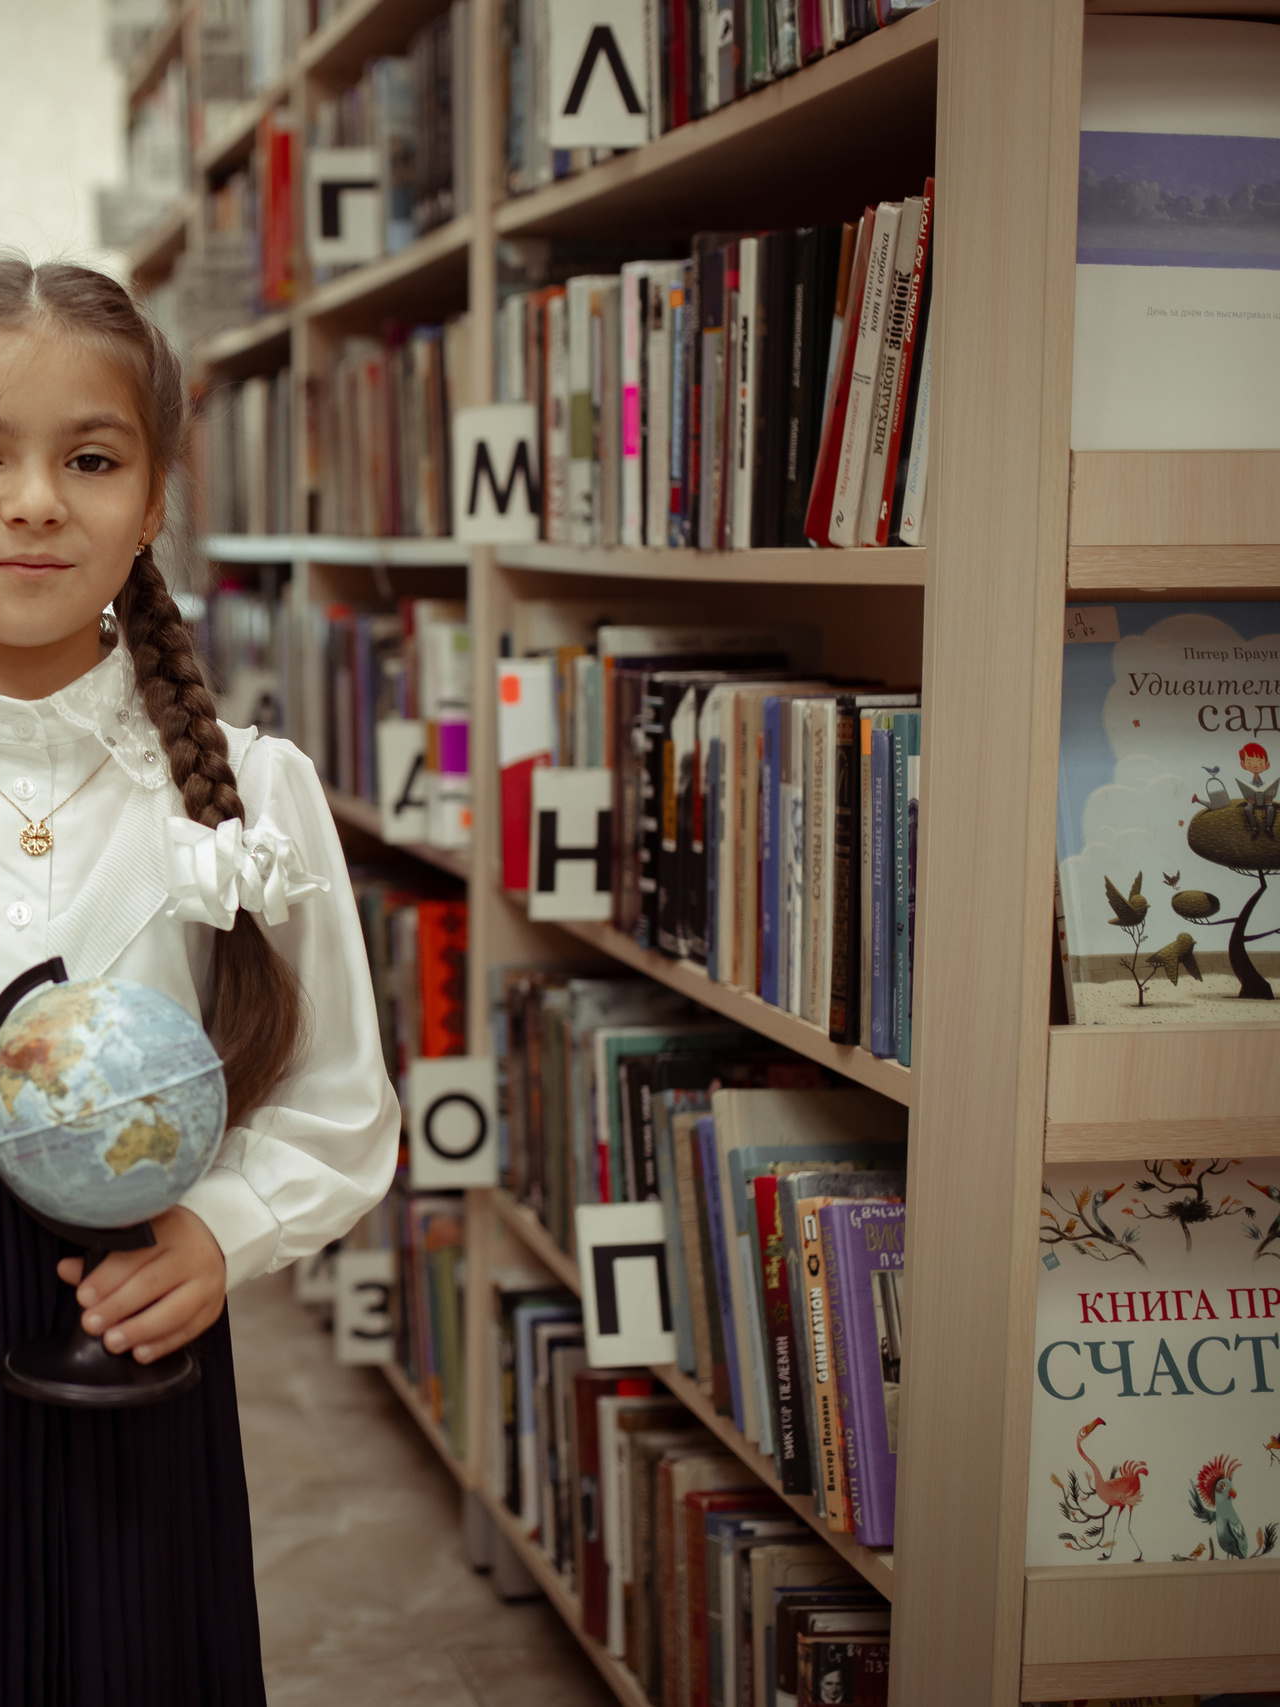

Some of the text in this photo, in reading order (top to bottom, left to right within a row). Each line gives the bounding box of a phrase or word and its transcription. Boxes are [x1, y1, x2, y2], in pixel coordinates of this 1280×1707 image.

[869, 301, 881, 333] кот
[876, 231, 891, 284] собака
[904, 196, 931, 343] ДОПЛЫТЬ ДО ГРОТА
[1146, 306, 1168, 317] День
[1169, 308, 1179, 317] за
[1203, 310, 1215, 318] он
[873, 355, 897, 456] МИХАЛКОВ
[467, 439, 543, 518] М
[1183, 646, 1280, 663] Питер Браун
[1197, 703, 1280, 739] сад
[894, 735, 904, 850] ВЛАСТЕЛИН
[536, 809, 613, 893] Н
[895, 855, 904, 907] ЗЛОЙ
[422, 1091, 488, 1162] О
[591, 1241, 674, 1336] П
[1076, 1288, 1220, 1324] КНИГА
[809, 1286, 829, 1384] GENERATION
[829, 1308, 849, 1377] ВИКТОР
[1037, 1332, 1280, 1401] СЧАСТ
[775, 1335, 796, 1460] ВИКТОР ПЕЛЕВИН
[821, 1395, 836, 1492] Виктор Пелевин
